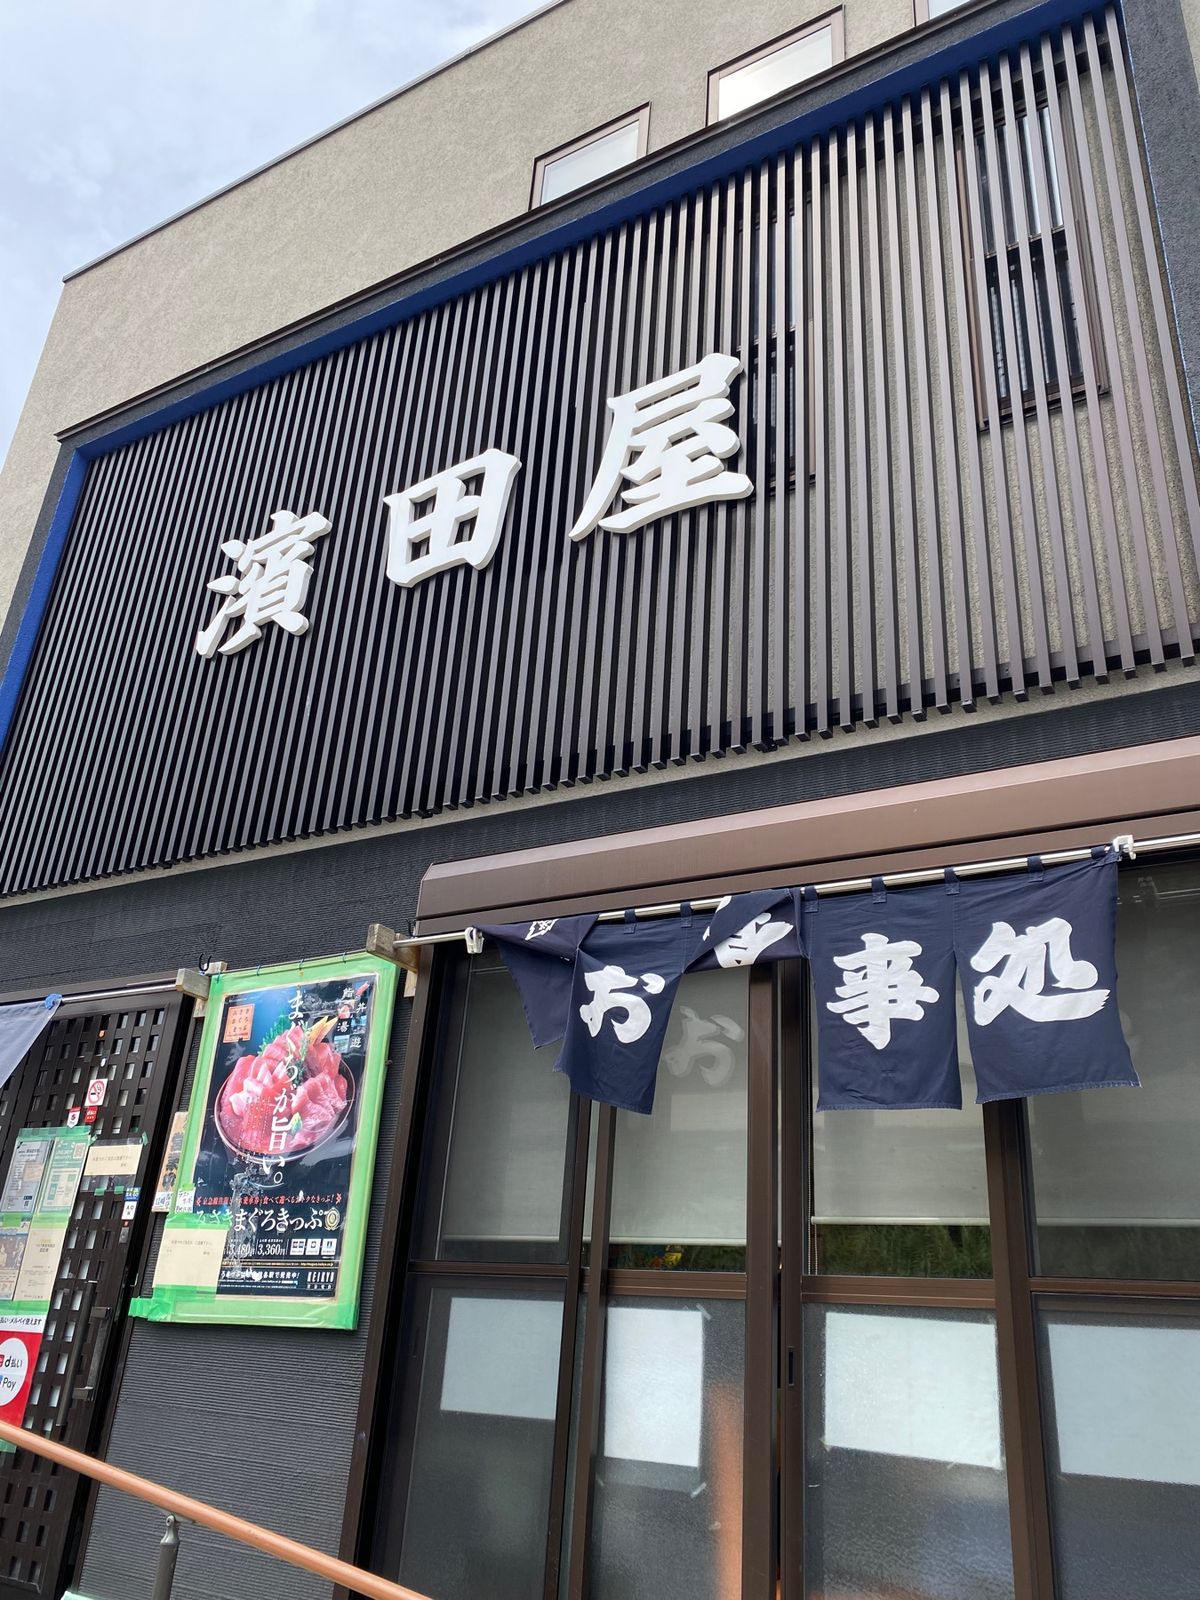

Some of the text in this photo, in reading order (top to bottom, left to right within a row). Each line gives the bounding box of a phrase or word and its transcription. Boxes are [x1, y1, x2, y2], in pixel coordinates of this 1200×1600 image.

[196, 353, 754, 659] 濱田屋
[262, 990, 306, 1186] まぐろが旨い。
[257, 1243, 286, 1256] 3,360円
